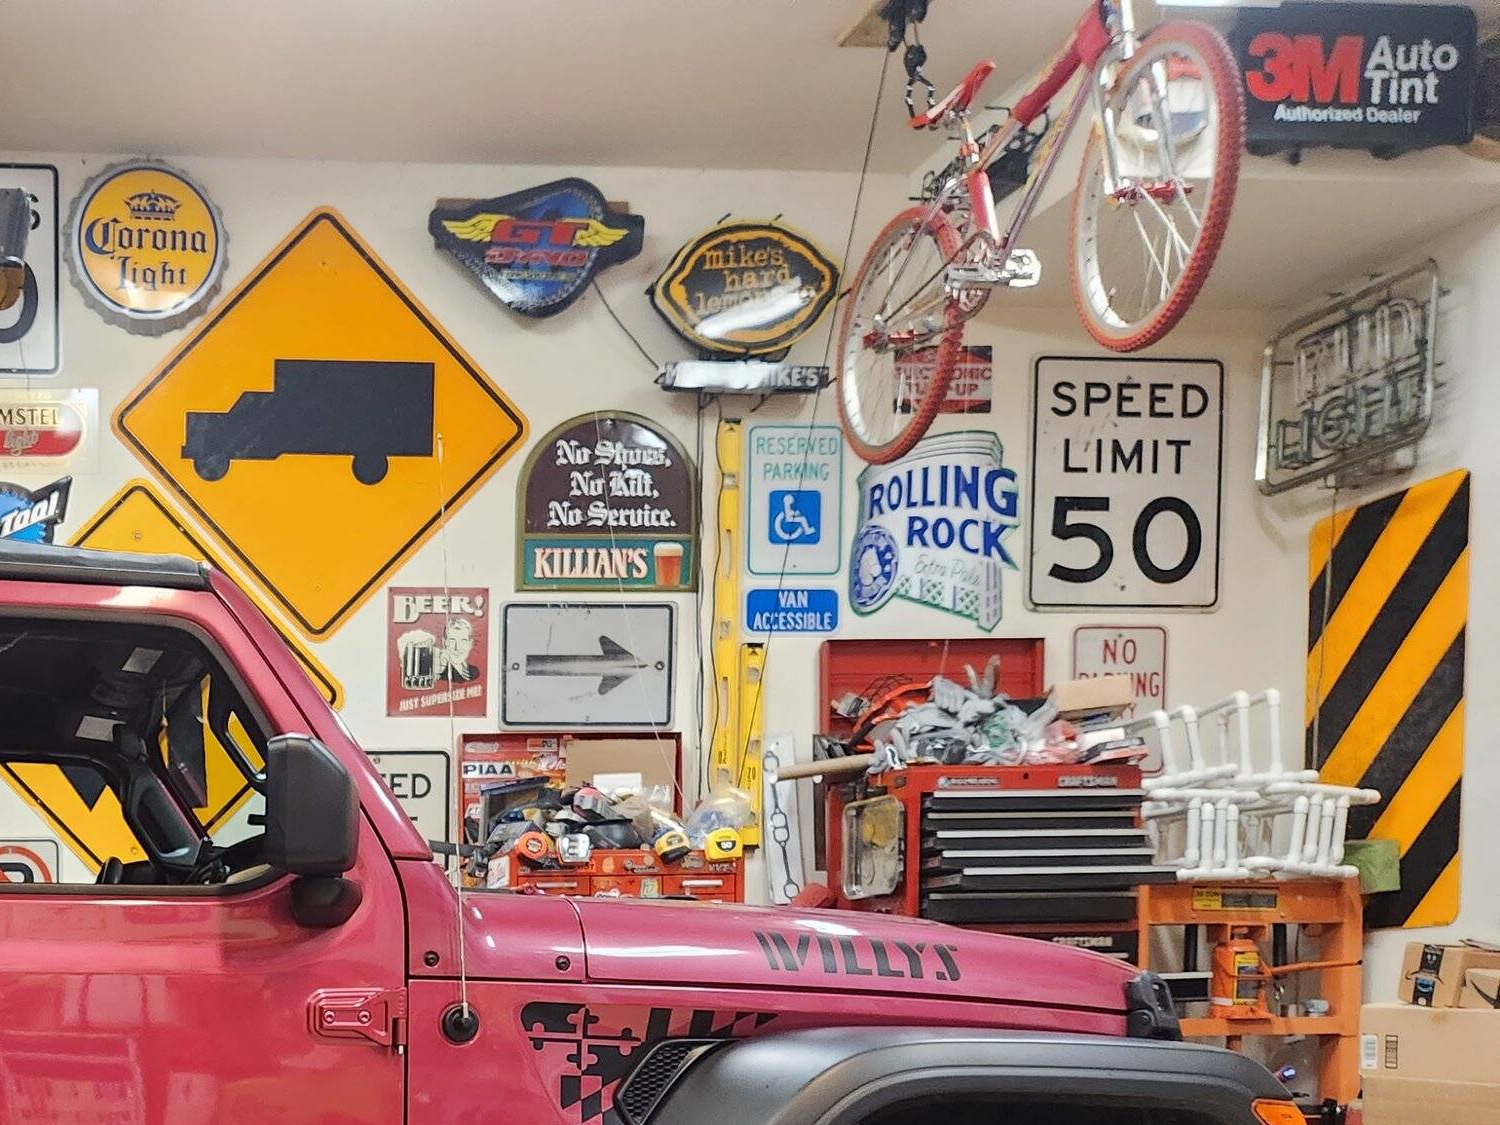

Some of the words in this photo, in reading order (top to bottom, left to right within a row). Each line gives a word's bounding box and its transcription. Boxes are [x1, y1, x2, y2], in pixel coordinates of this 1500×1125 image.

[1246, 32, 1365, 104] 3M
[1366, 35, 1459, 72] Auto
[1364, 70, 1439, 105] Tint
[1274, 104, 1364, 123] Authorized
[1366, 107, 1422, 124] Dealer
[85, 217, 207, 257] Corona
[491, 219, 590, 246] GT
[703, 243, 784, 268] mike's
[724, 263, 791, 292] hard
[1051, 381, 1210, 419] SPEED
[555, 439, 592, 467] No
[756, 436, 838, 456] RESERVED
[1063, 438, 1191, 474] LIMIT
[569, 470, 605, 497] No
[763, 462, 830, 481] PARKING
[868, 465, 1020, 520] ROLLING
[546, 500, 584, 529] No
[906, 516, 1020, 571] ROCK
[1048, 496, 1202, 584] 50
[533, 547, 649, 579] KILLIAN'S
[393, 595, 484, 624] BEER!
[777, 590, 809, 608] VAN
[752, 611, 833, 631] ACCESSIBLE
[1102, 639, 1137, 665] NO
[463, 763, 513, 775] PIAA
[753, 928, 961, 982] WILLYS
